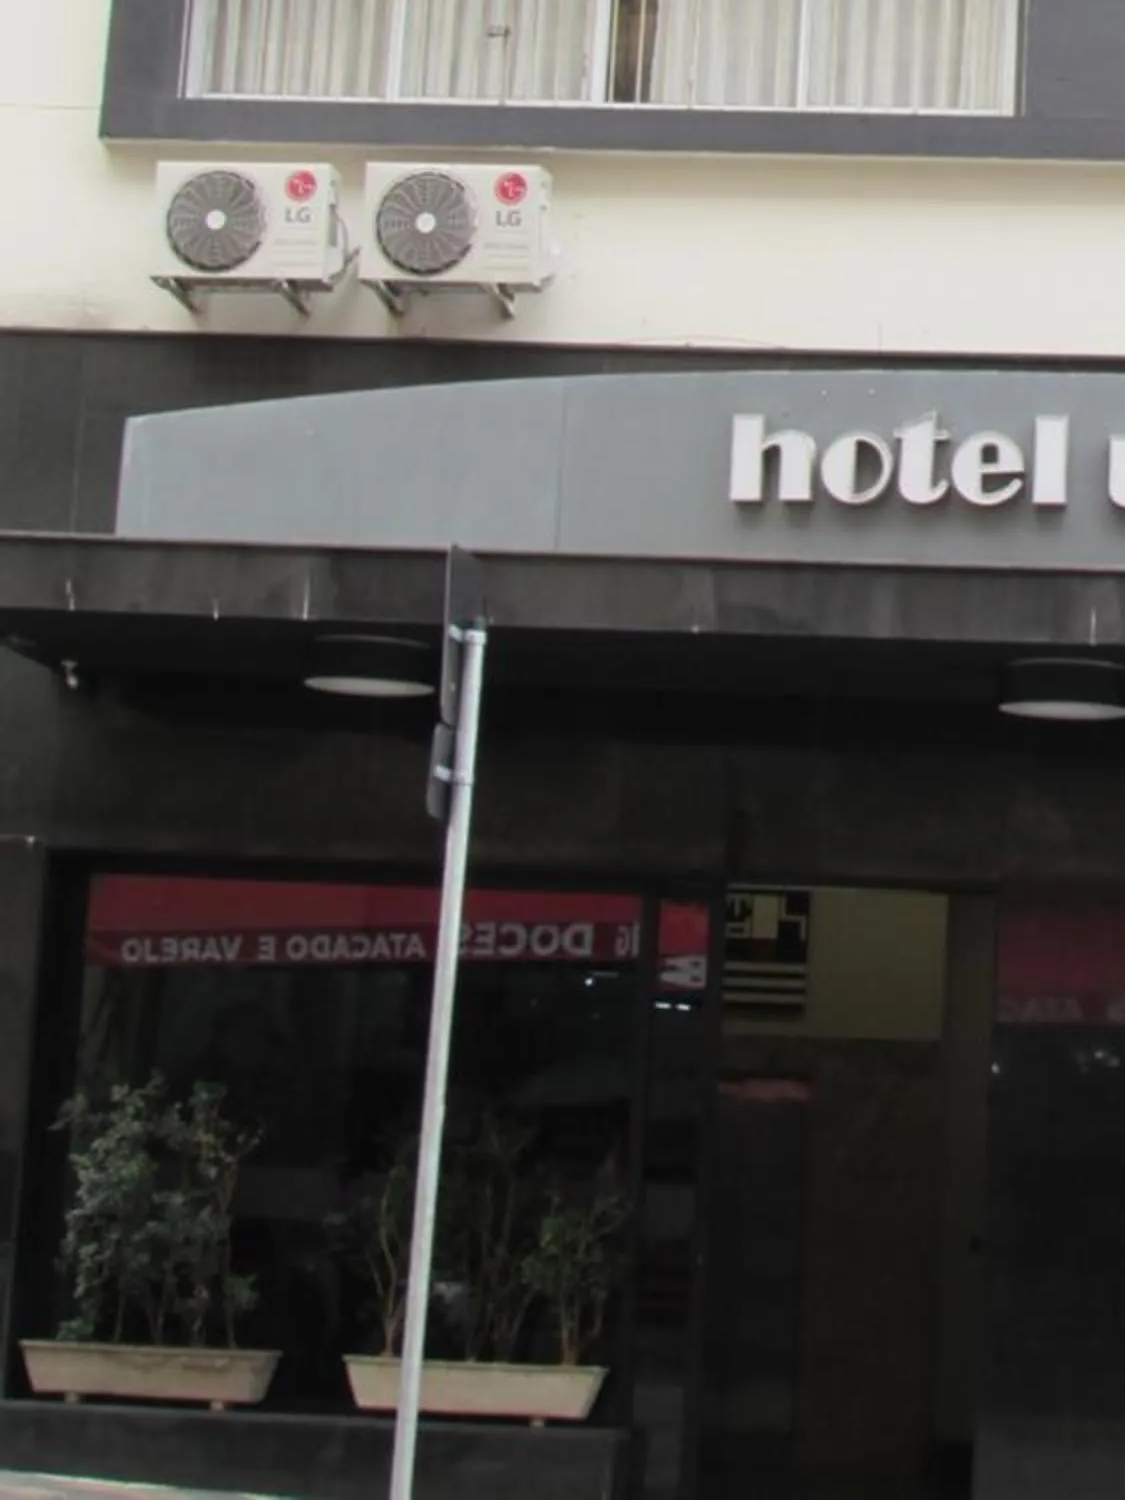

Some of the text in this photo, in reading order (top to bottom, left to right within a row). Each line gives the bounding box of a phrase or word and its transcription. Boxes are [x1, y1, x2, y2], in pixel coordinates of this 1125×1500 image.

[285, 207, 312, 224] LG
[495, 209, 522, 227] LG
[729, 409, 1070, 506] hotel
